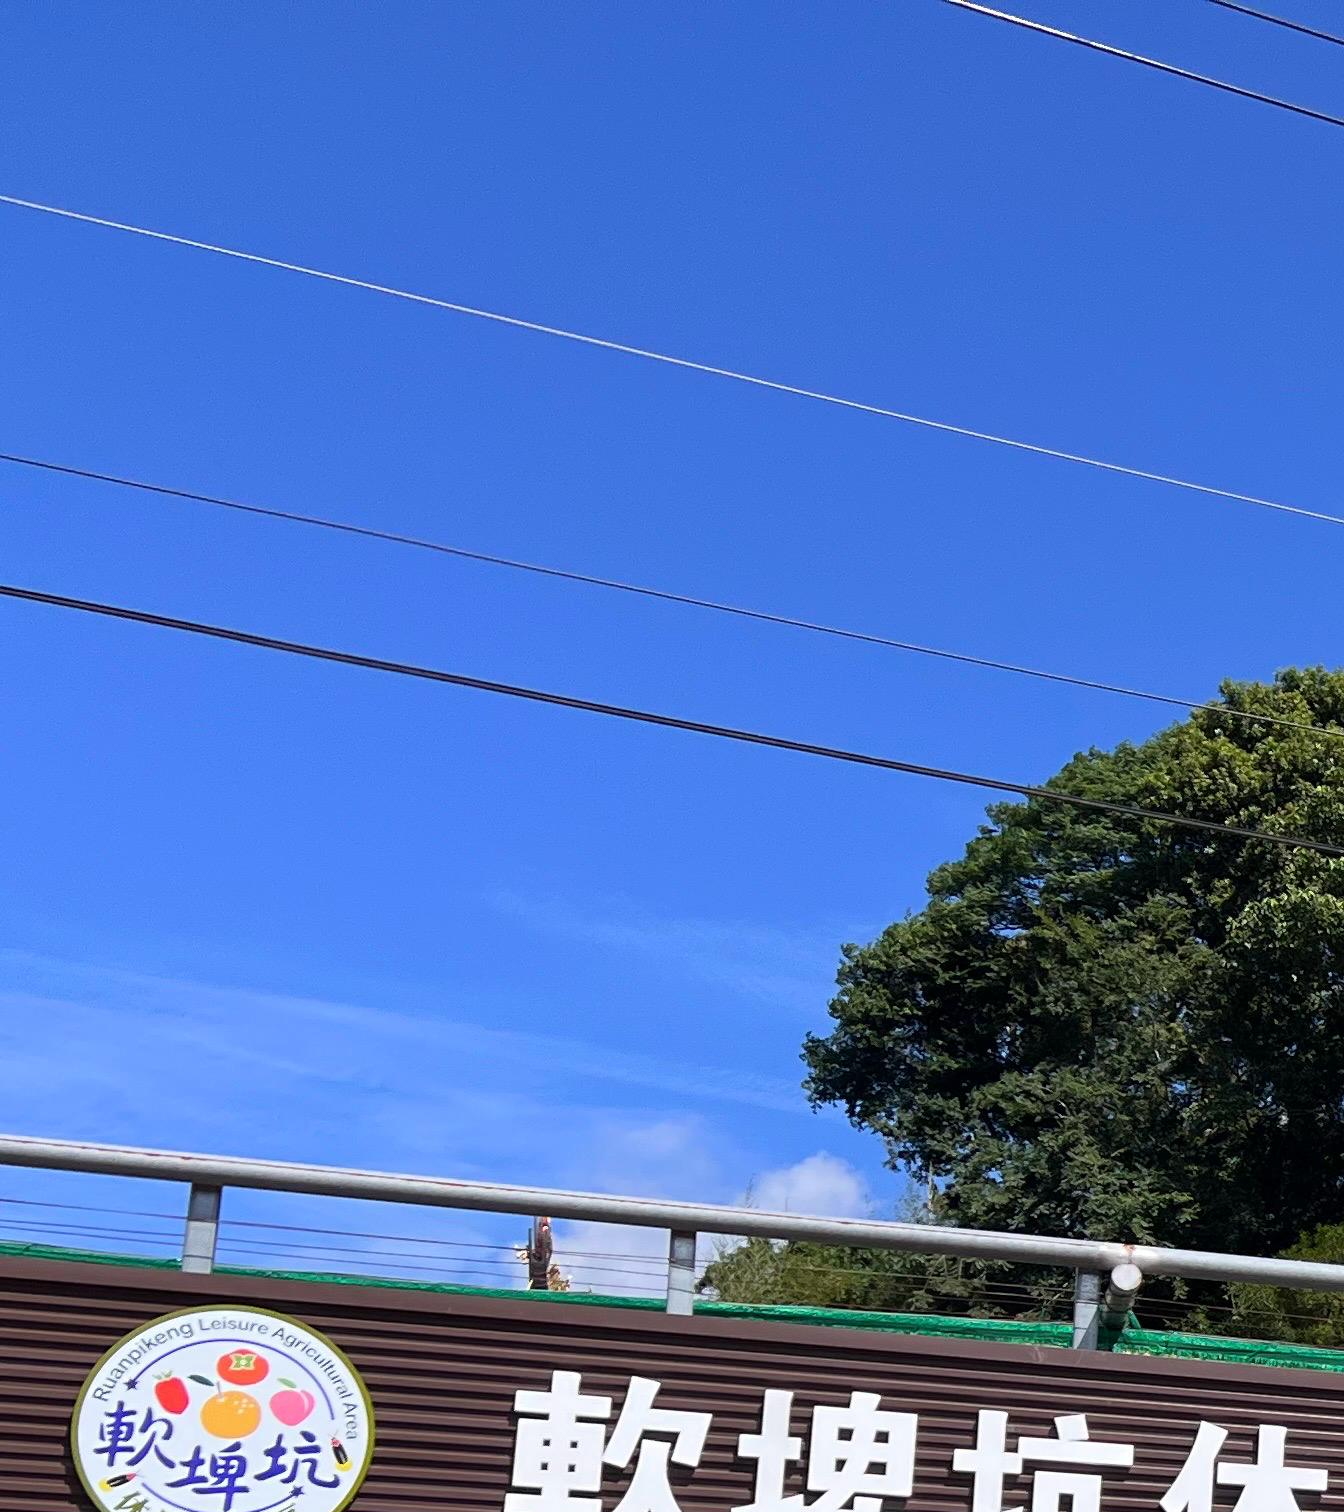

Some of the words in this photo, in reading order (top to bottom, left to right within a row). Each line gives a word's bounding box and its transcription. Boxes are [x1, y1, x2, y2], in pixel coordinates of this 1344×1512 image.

[93, 1322, 194, 1402] Ruanpikeng
[198, 1316, 269, 1335] Leisure
[271, 1326, 352, 1401] Agricultural
[342, 1400, 359, 1440] Area
[93, 1400, 341, 1512] 軟埤坑
